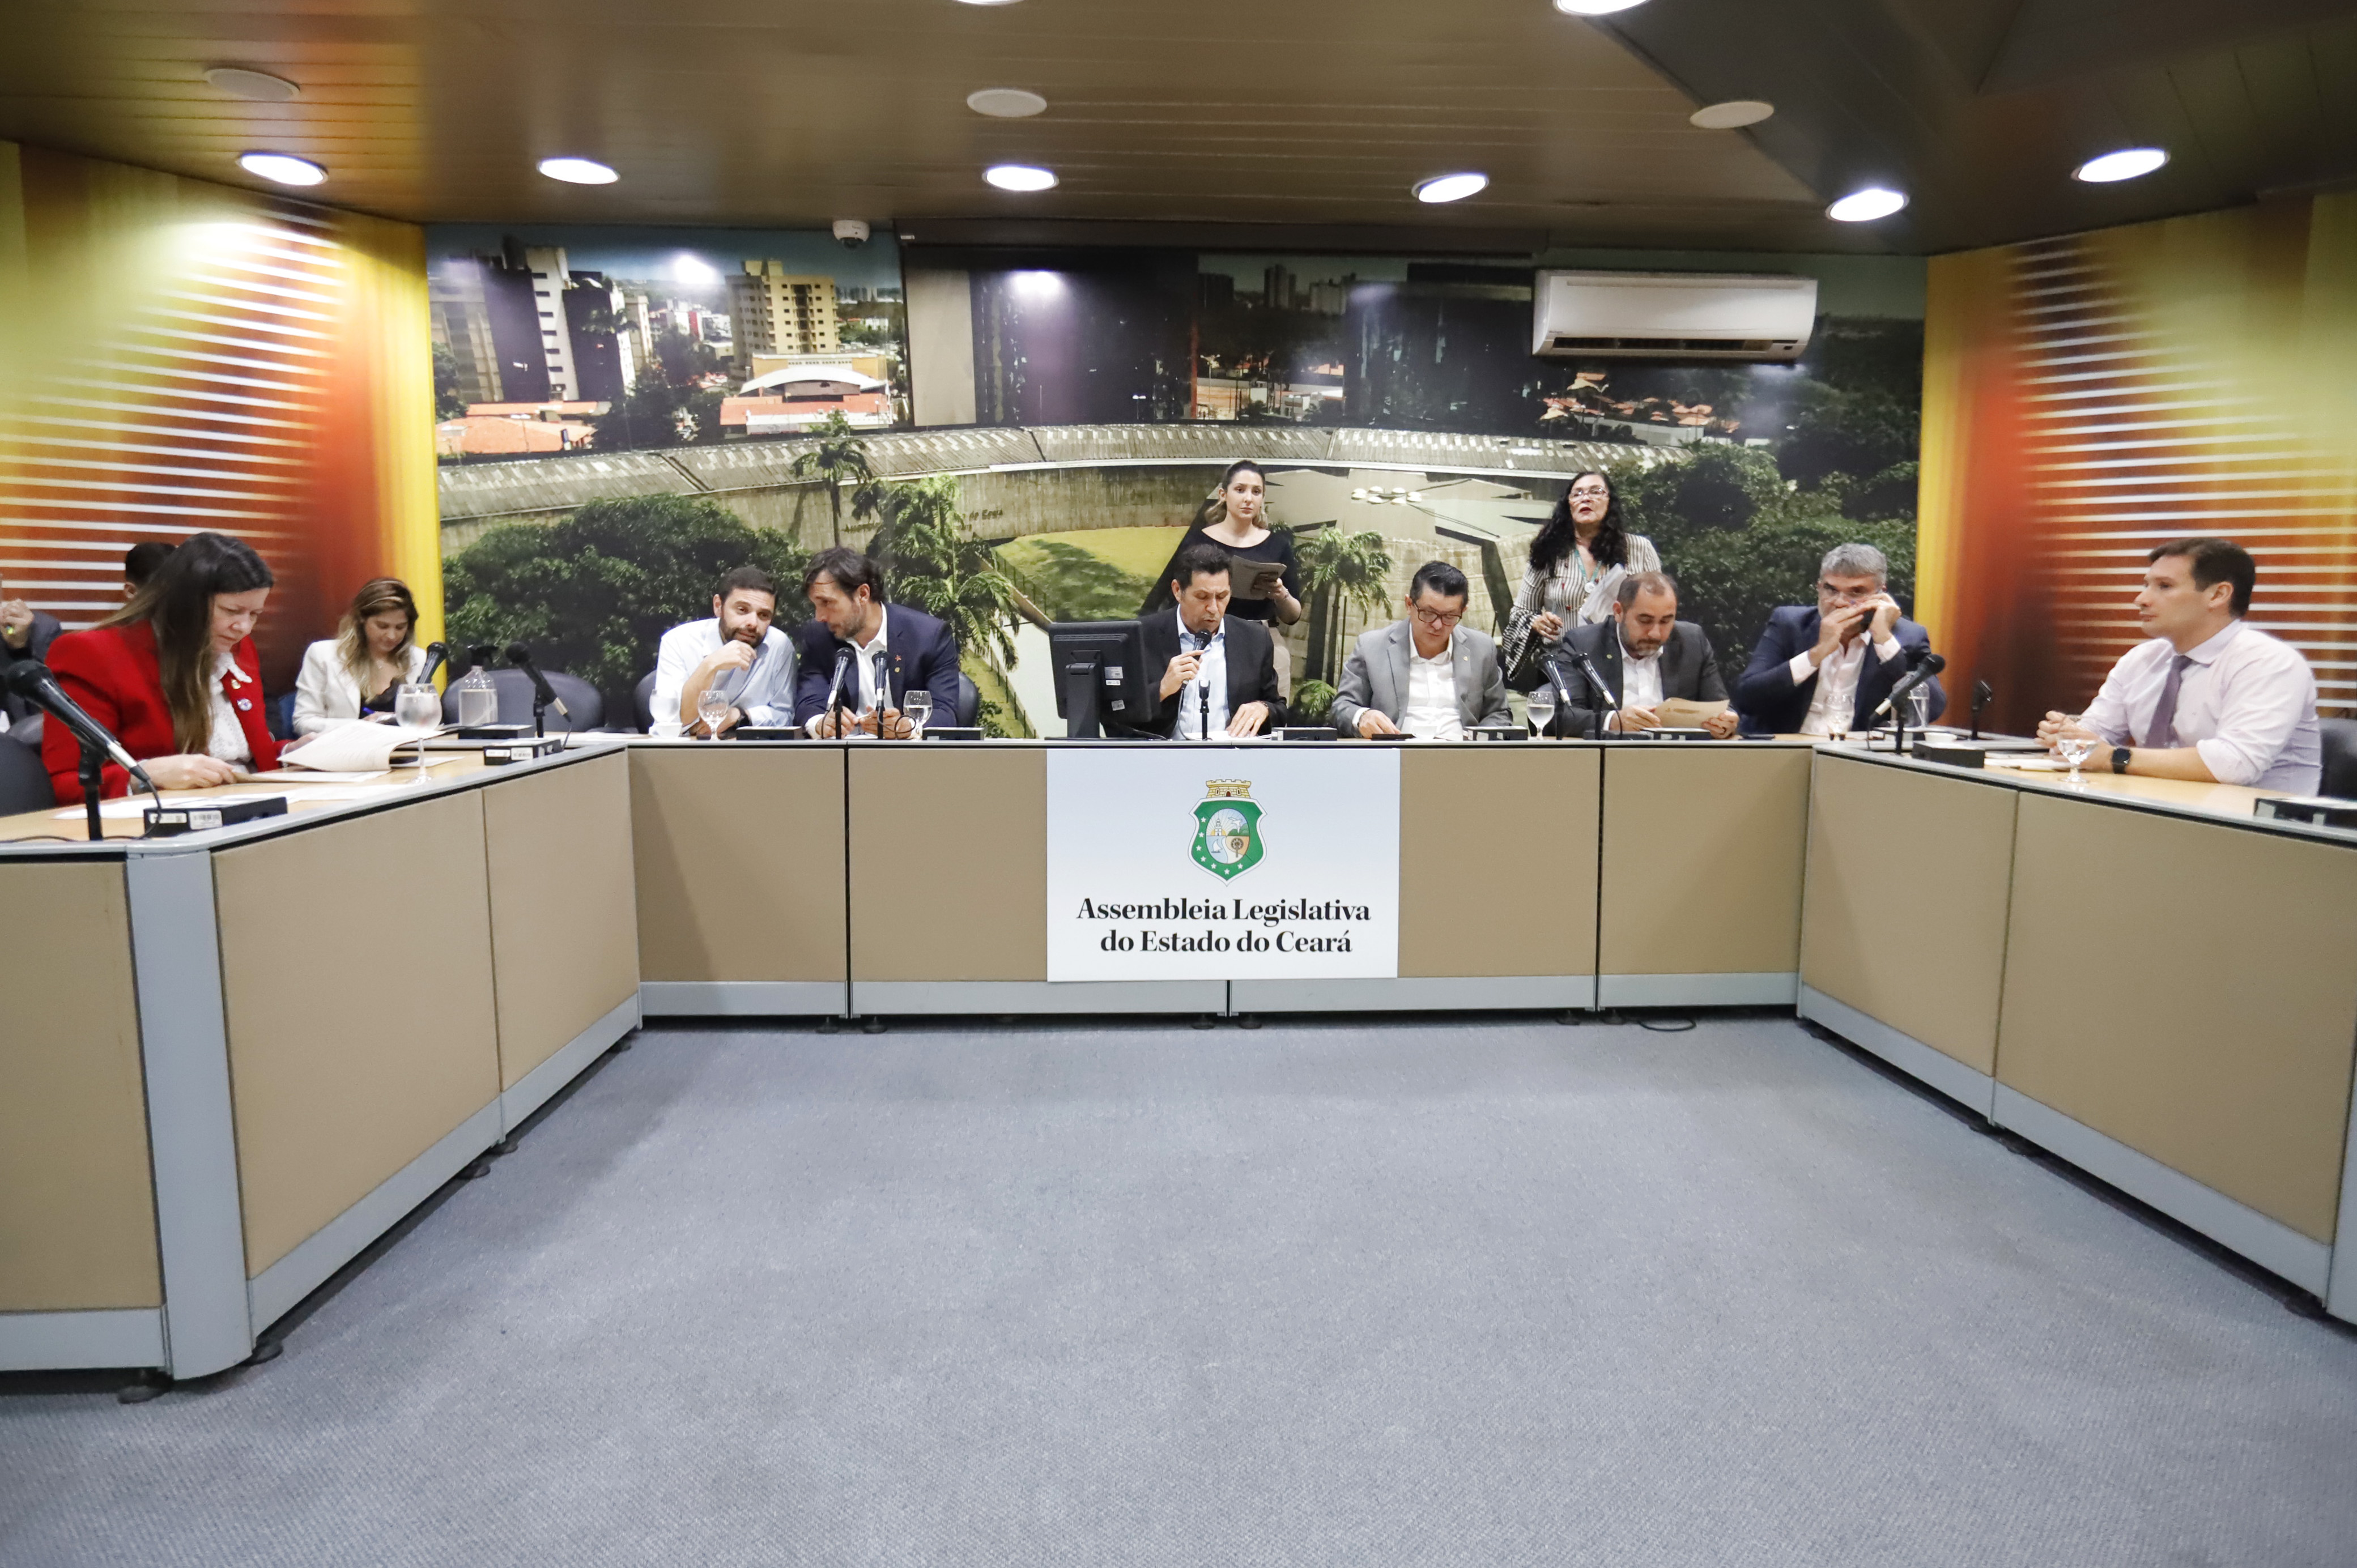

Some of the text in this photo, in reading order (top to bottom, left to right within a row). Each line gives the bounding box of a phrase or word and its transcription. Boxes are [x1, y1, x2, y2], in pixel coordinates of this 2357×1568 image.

[1077, 897, 1371, 927] Assembleia Legislativa
[1100, 929, 1352, 952] do Estado do Ceará
